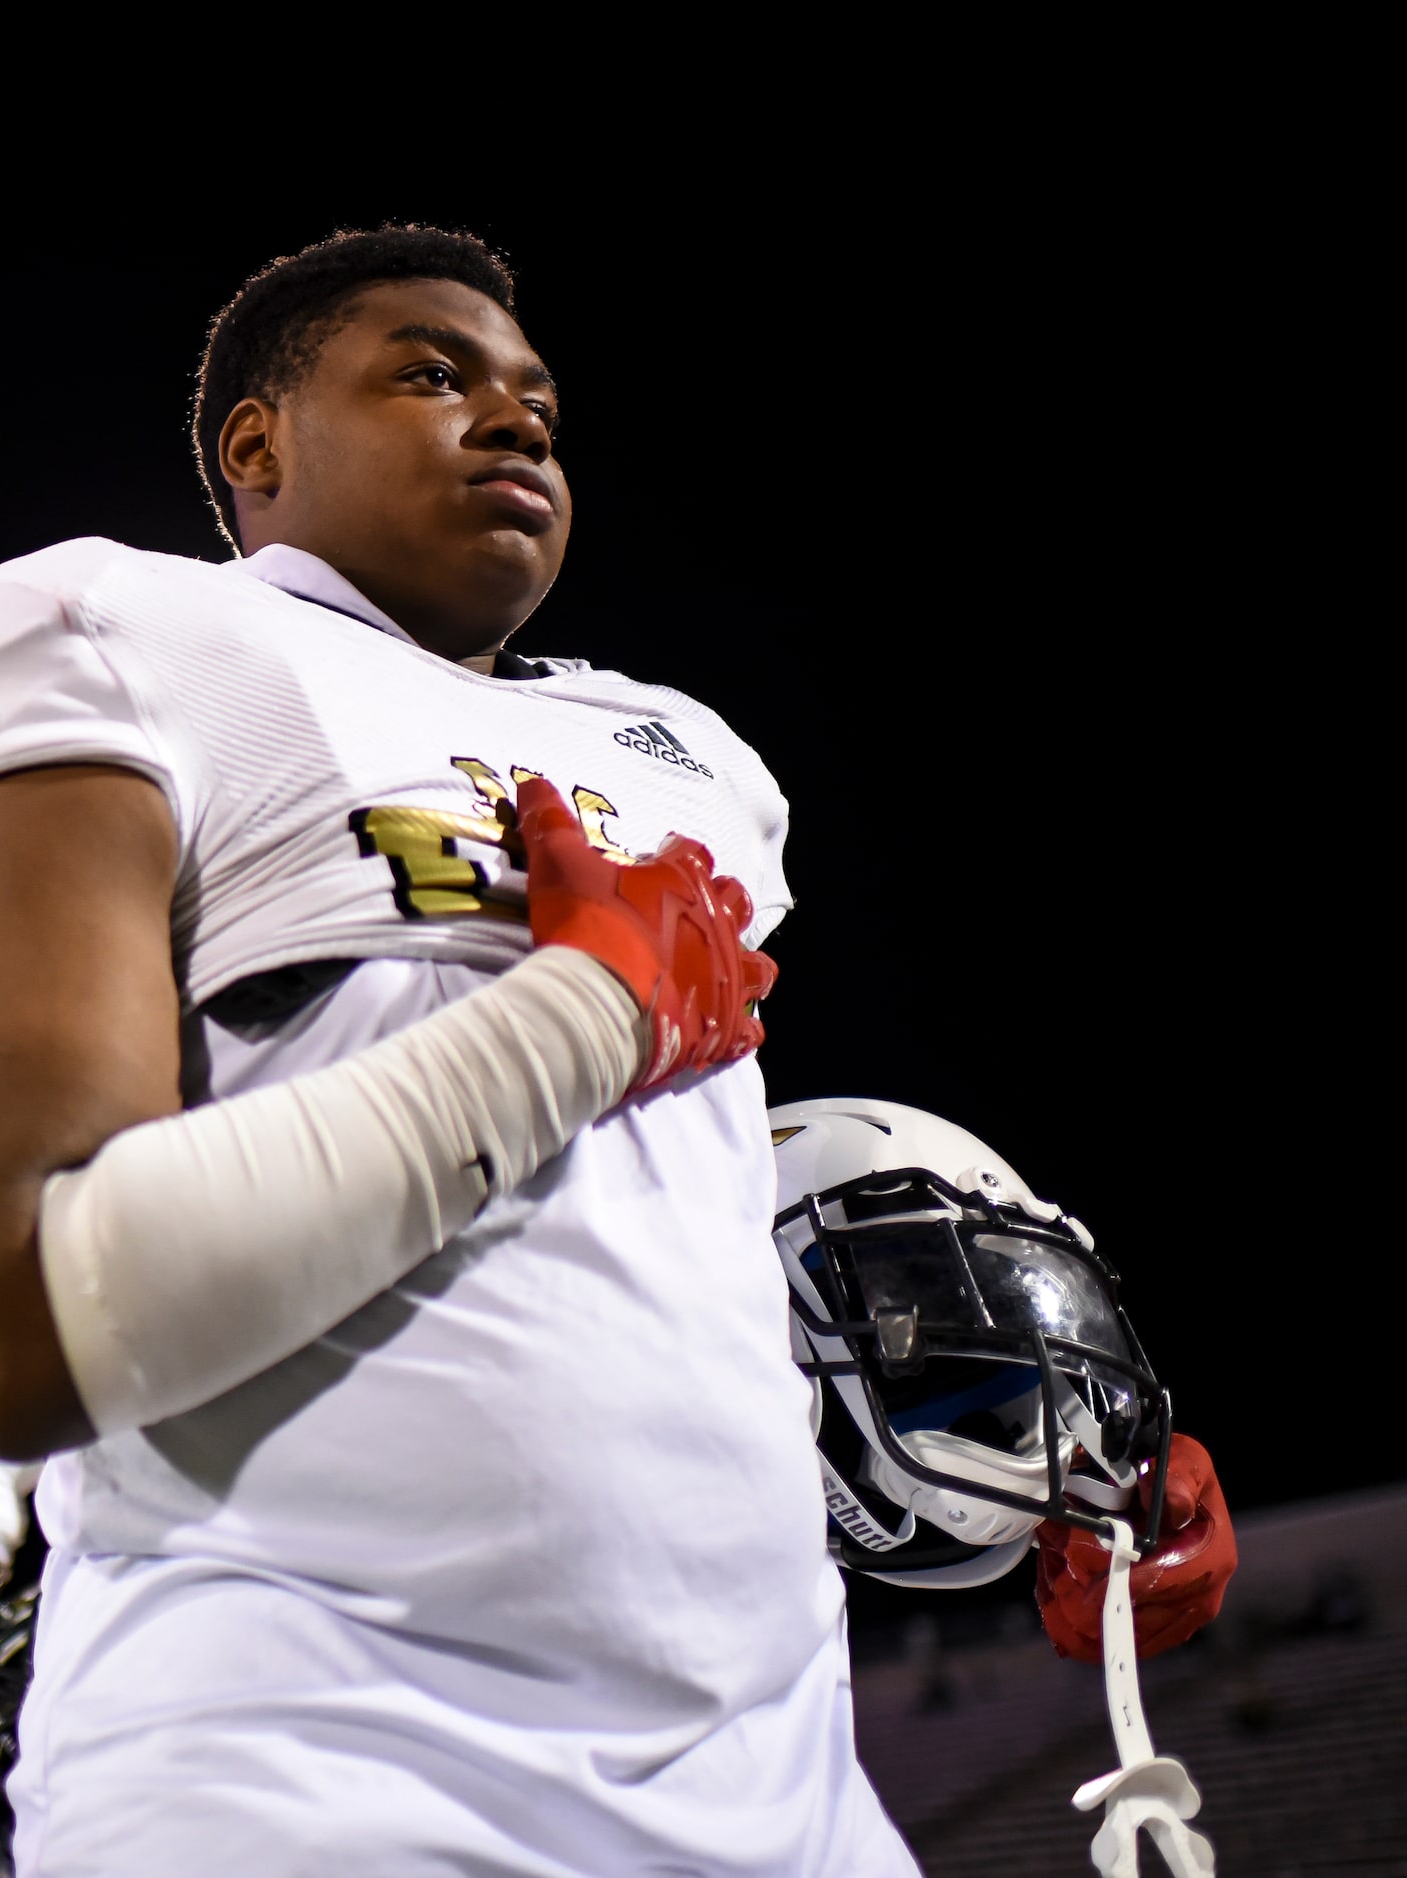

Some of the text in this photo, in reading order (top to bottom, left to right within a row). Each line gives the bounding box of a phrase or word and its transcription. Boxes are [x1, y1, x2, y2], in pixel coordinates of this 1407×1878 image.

[613, 732, 714, 780] adidas
[450, 756, 639, 866] SC
[822, 1476, 893, 1550] schutt
